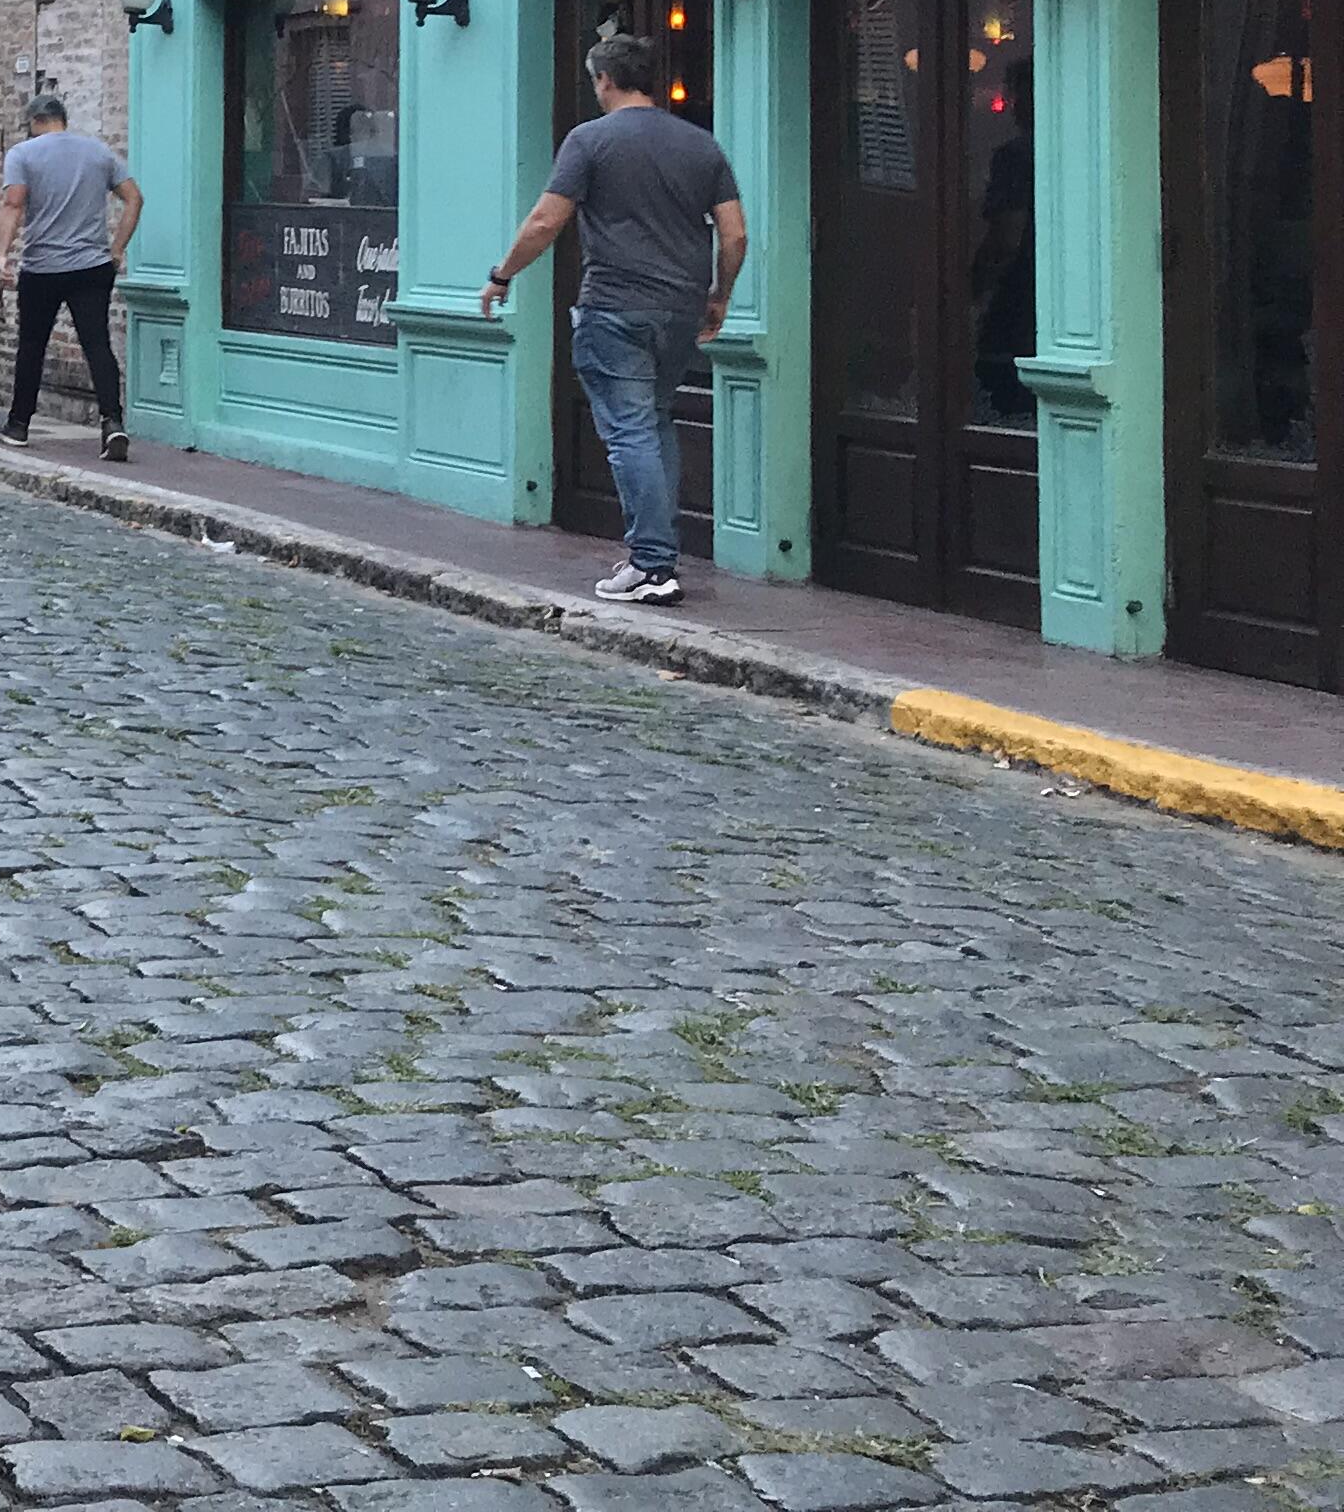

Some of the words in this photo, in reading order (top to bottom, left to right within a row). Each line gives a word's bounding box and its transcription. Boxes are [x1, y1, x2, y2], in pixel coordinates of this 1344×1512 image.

[283, 227, 330, 256] FAJITAS
[296, 263, 316, 280] AND
[279, 286, 330, 318] BURRITOS
